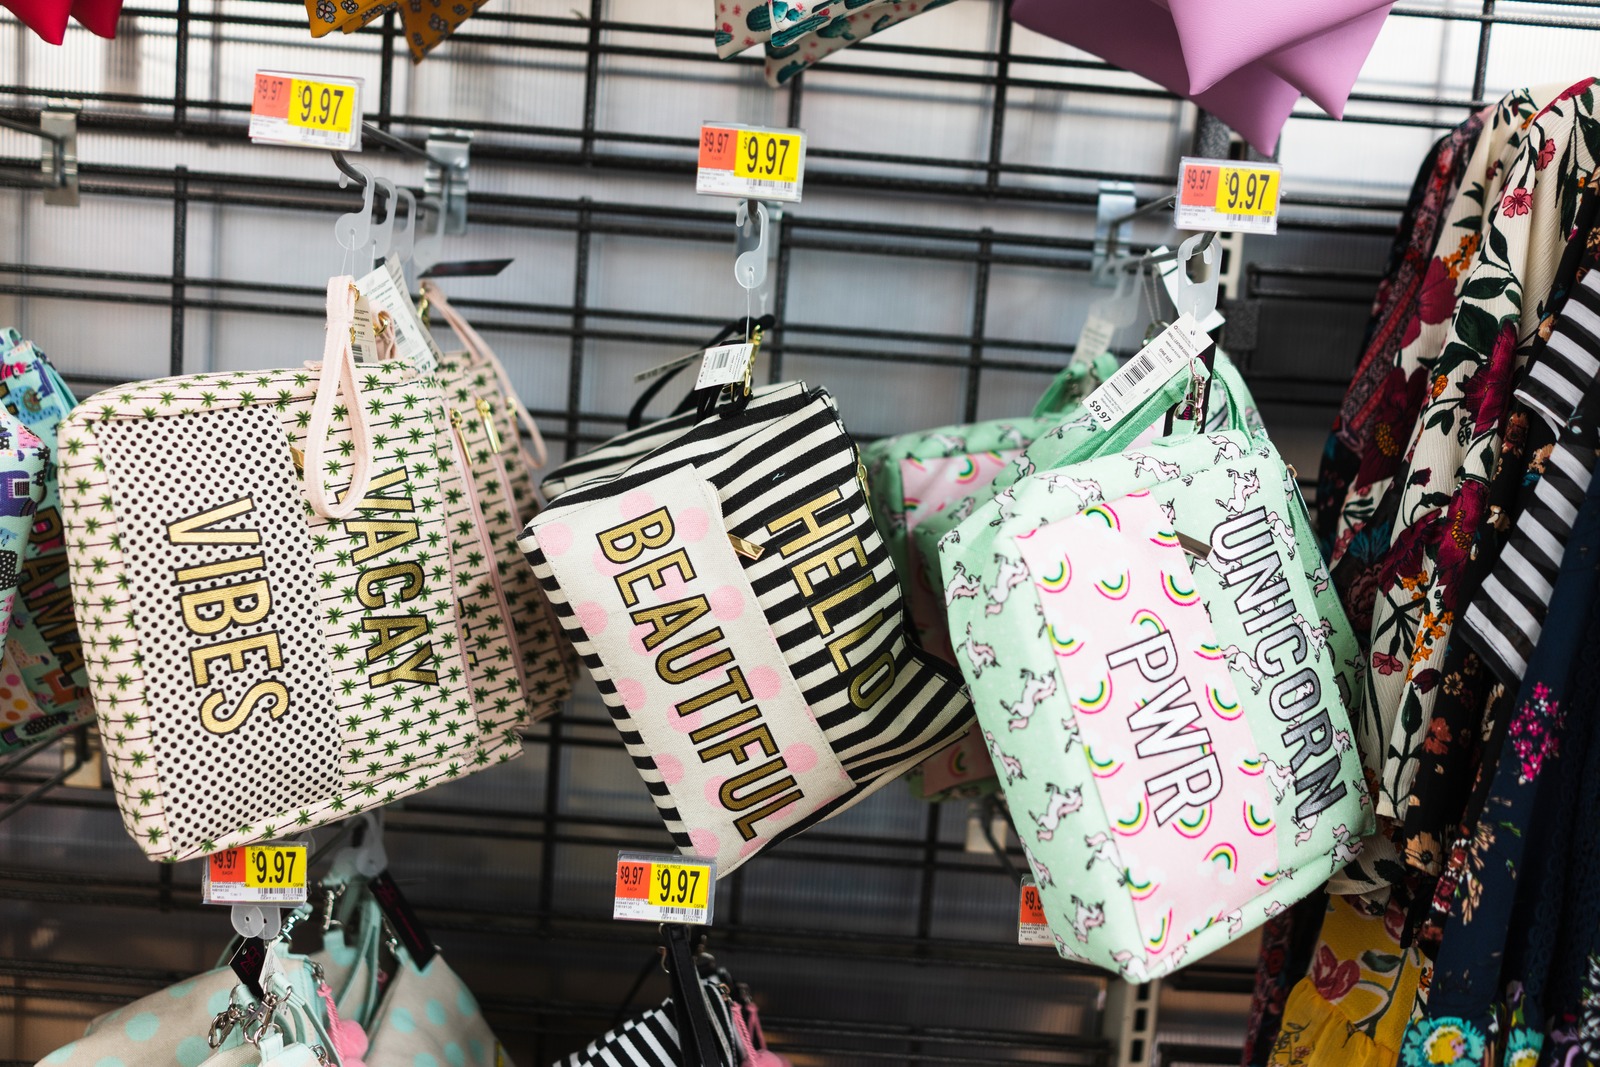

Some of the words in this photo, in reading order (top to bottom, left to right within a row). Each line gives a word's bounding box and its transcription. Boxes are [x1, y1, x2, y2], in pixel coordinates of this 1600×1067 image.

[258, 78, 283, 101] $9.97
[297, 85, 344, 126] $9.97
[704, 131, 729, 154] $9.97
[744, 136, 790, 175] $9.97
[1187, 169, 1212, 190] $9.97
[1225, 172, 1270, 210] $9.97
[1089, 400, 1112, 424] $9.97
[335, 465, 439, 688] VACAY
[166, 497, 290, 736] VIBES
[765, 488, 895, 712] HELLO
[596, 505, 805, 842] BEAUTIFUL
[1209, 505, 1350, 822] UNICORN
[1106, 629, 1224, 827] PWR
[213, 850, 238, 869] $9.97
[252, 850, 296, 883] $9.97
[620, 865, 644, 885] $9.97
[657, 868, 700, 904] $9.97
